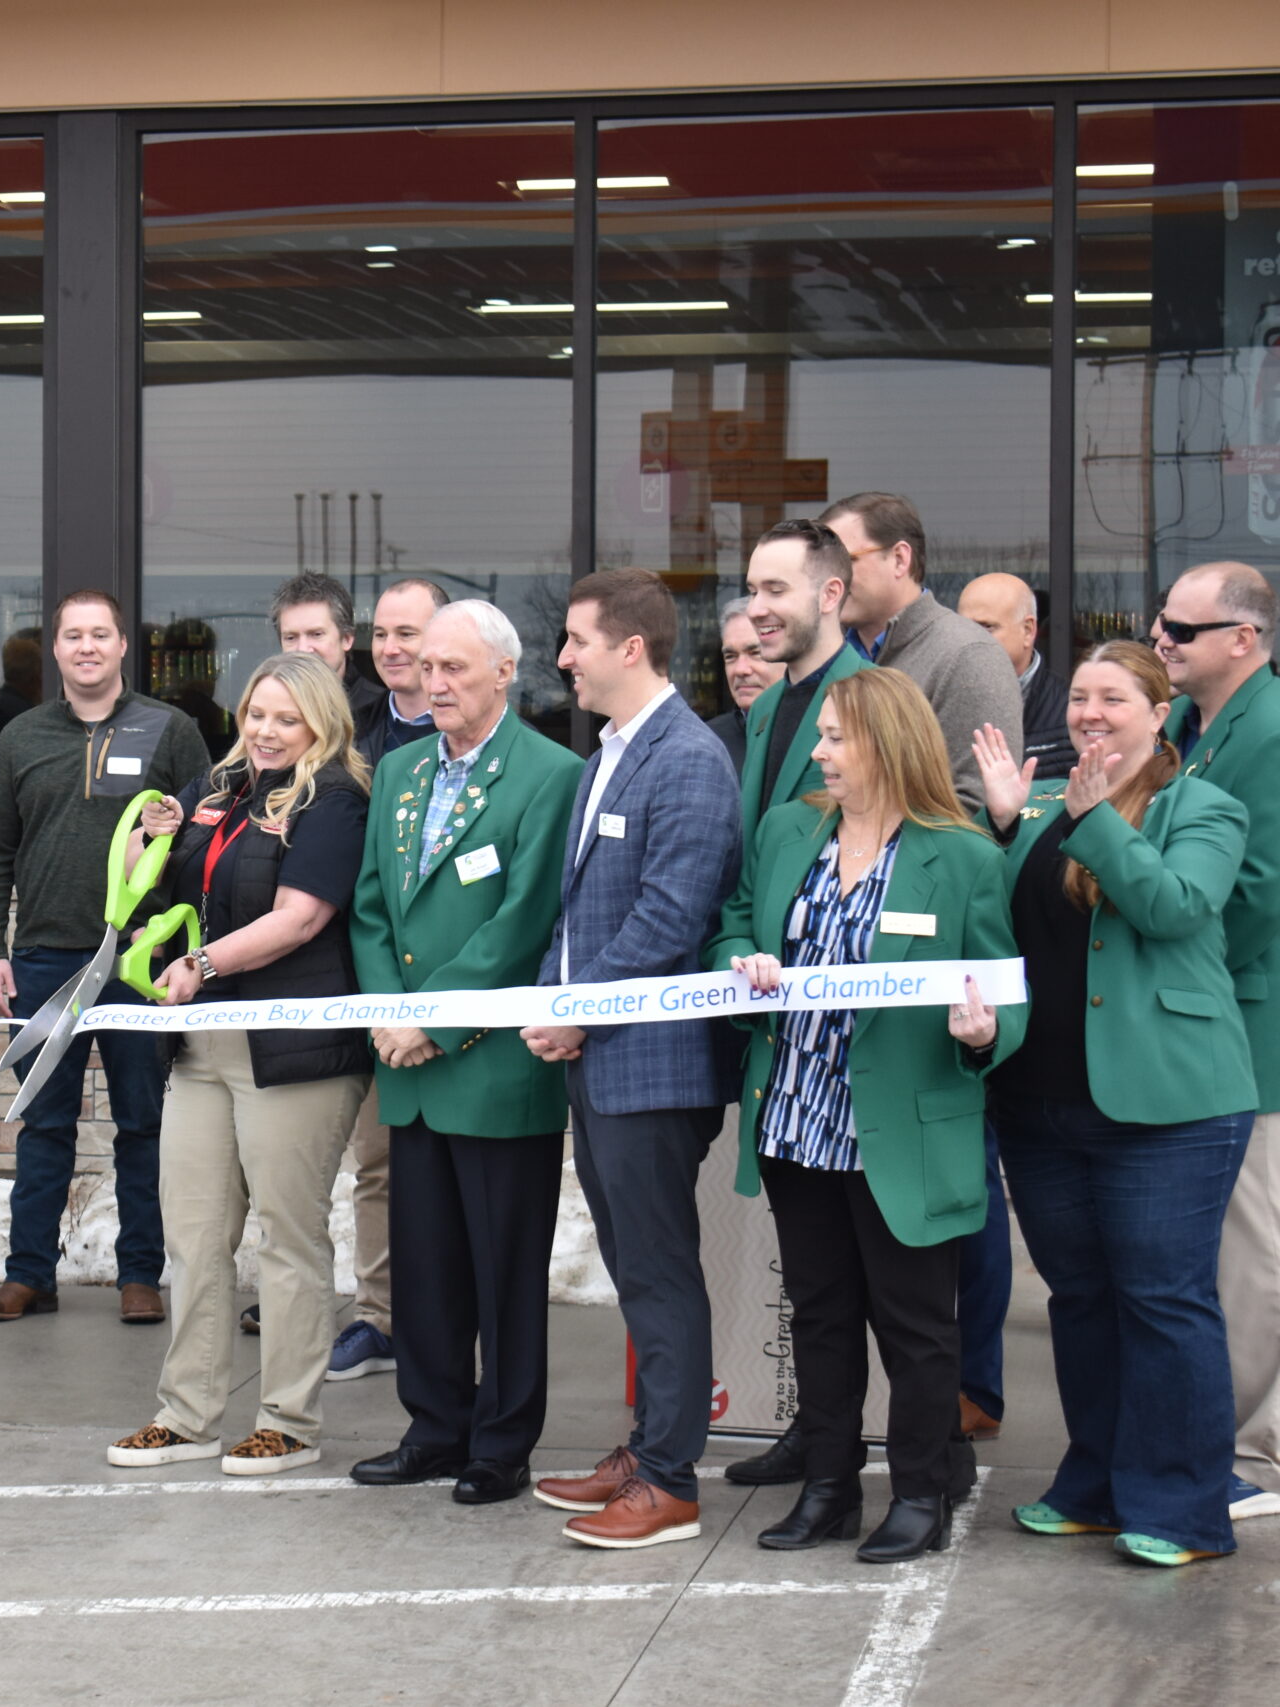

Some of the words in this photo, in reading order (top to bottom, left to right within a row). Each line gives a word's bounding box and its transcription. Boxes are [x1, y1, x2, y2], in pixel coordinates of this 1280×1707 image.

[550, 993, 649, 1017] Greater
[659, 984, 737, 1011] Green
[803, 971, 927, 1000] Chamber
[83, 1009, 177, 1026] Greater
[185, 1009, 258, 1024] Green
[268, 1003, 313, 1025] Bay
[322, 1001, 440, 1021] Chamber
[776, 1359, 786, 1379] the
[787, 1366, 797, 1379] of
[777, 1382, 785, 1395] to
[775, 1399, 787, 1421] Pay
[786, 1383, 796, 1418] Order
